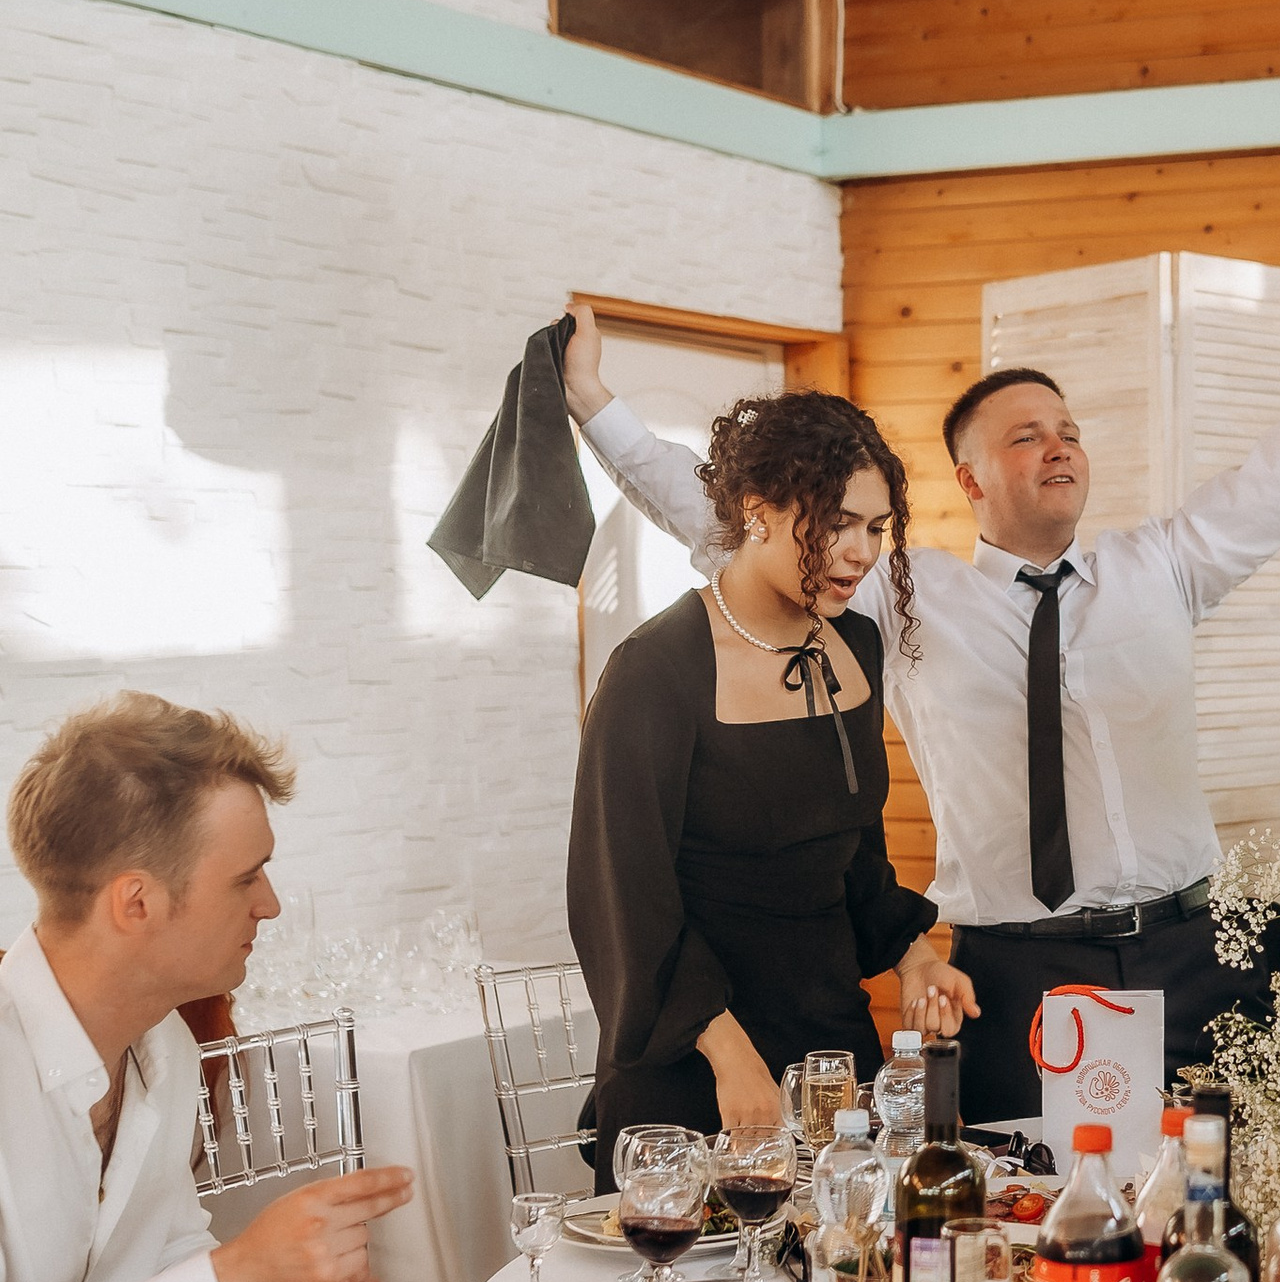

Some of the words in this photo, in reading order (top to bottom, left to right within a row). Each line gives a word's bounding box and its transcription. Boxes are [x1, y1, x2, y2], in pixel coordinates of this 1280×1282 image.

[1076, 1059, 1112, 1084] ВОЛОГОДСКАЯ
[1112, 1062, 1131, 1084] ОБЛАСТЬ
[1086, 1103, 1116, 1115] РУССКОГО
[1115, 1089, 1131, 1110] СЕВЕРА
